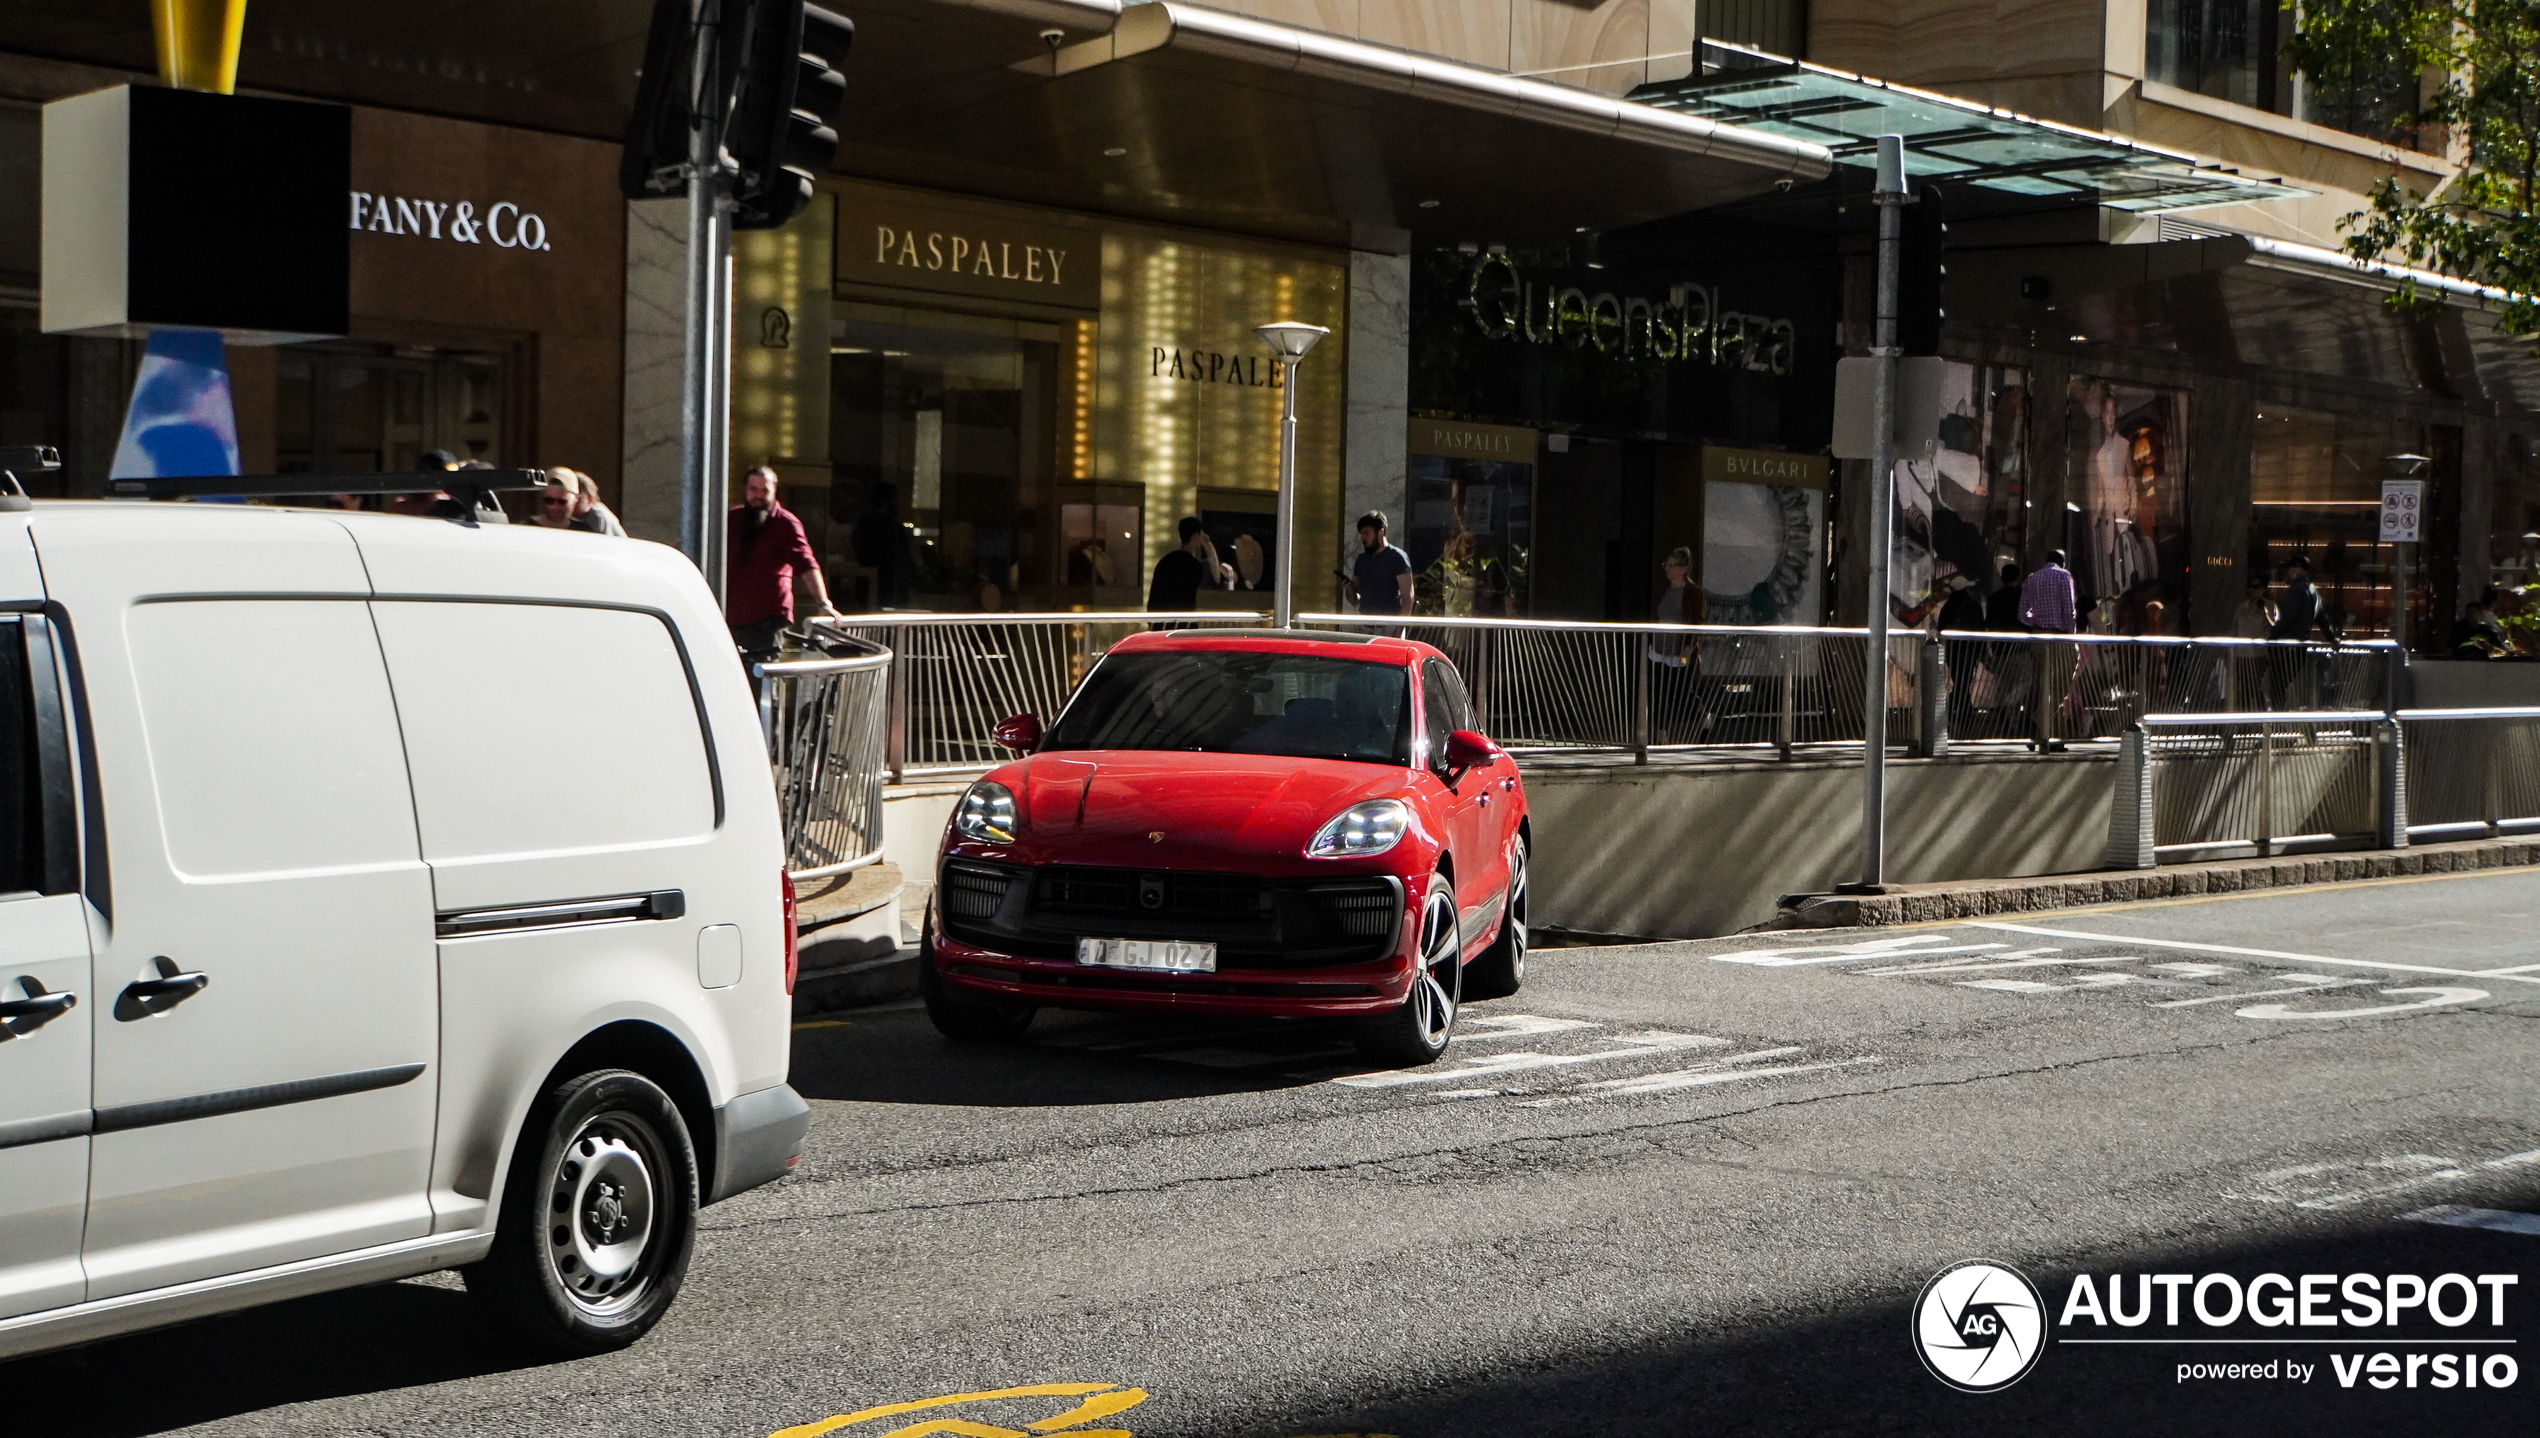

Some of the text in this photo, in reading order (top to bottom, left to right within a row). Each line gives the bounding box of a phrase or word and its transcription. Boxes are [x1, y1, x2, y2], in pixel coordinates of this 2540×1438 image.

[350, 191, 449, 240] FANY
[877, 226, 1066, 285] PASPALEY
[1152, 347, 1302, 389] PASPALE
[1434, 429, 1512, 453] PASPALEY
[1727, 456, 1807, 479] BVLGARI
